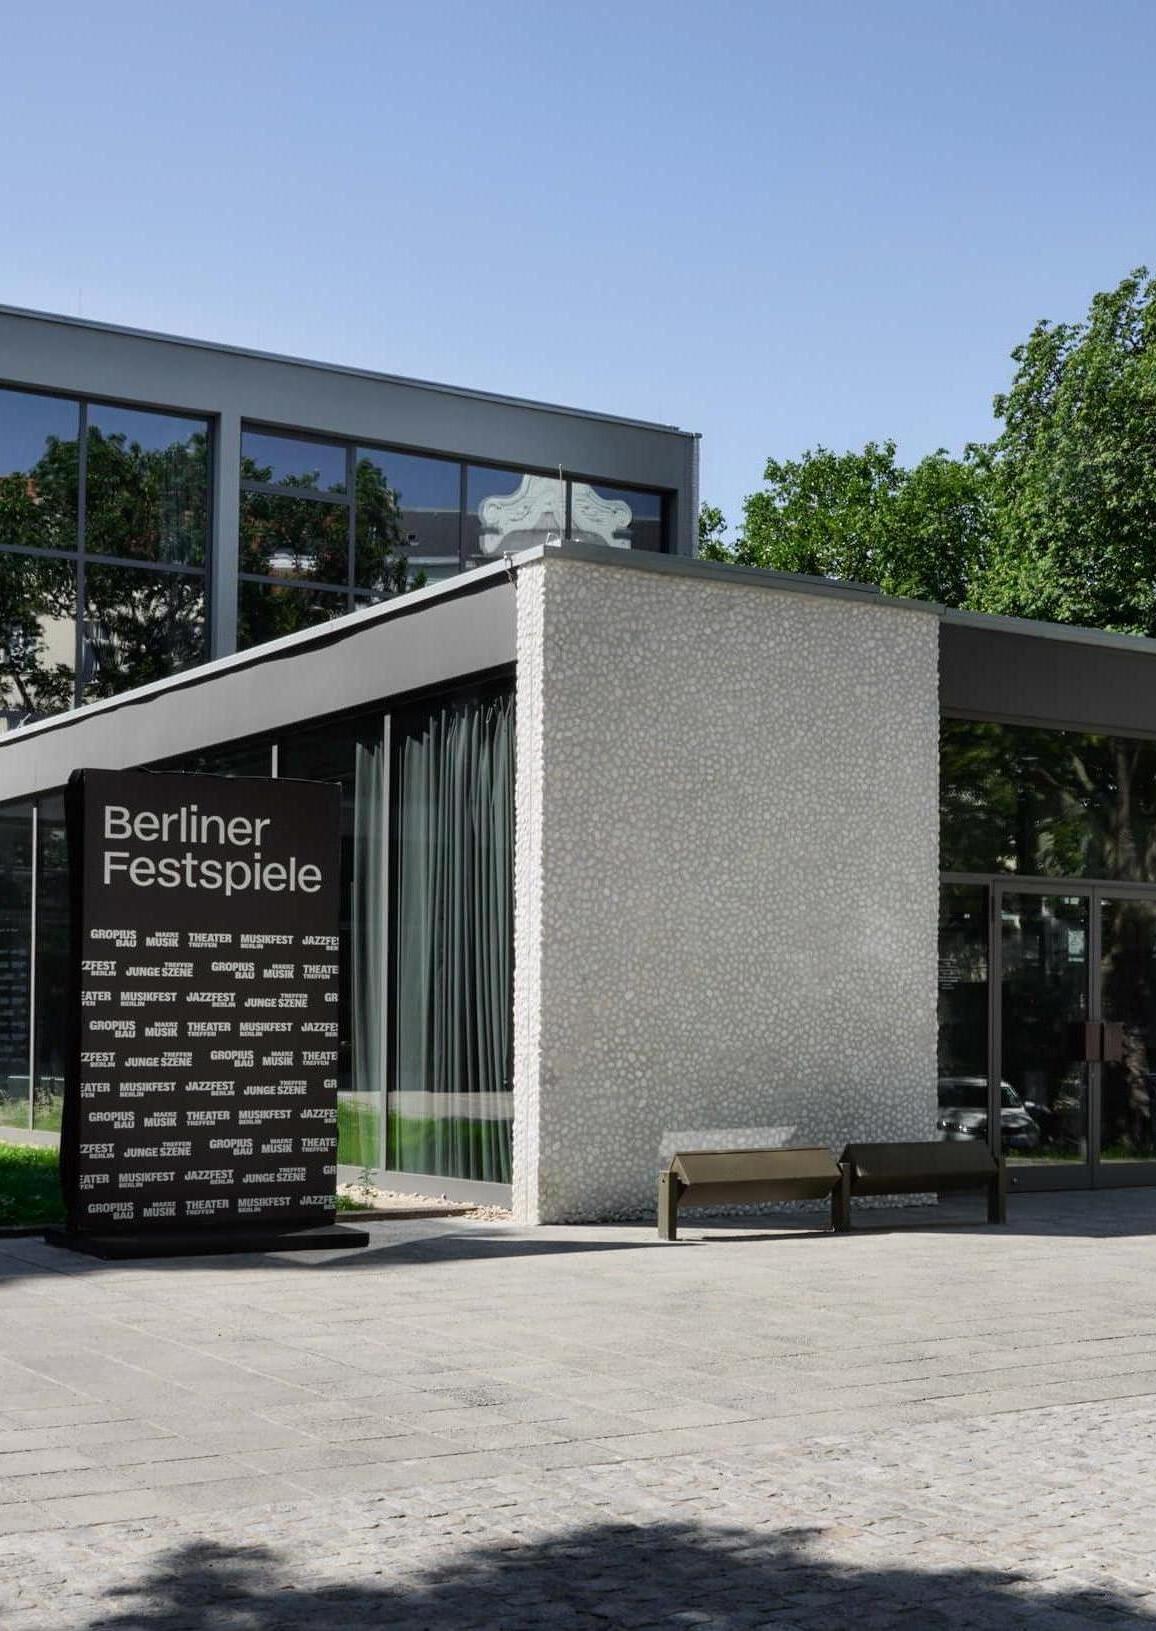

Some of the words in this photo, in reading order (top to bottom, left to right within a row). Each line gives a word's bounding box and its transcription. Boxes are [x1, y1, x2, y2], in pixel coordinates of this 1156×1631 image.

[104, 804, 271, 846] Berliner
[103, 851, 322, 896] Festspiele
[91, 929, 136, 940] GROPIUS
[188, 933, 232, 943] THEATER
[240, 934, 294, 944] MUSIKFEST
[116, 939, 136, 947] BAU
[146, 937, 178, 947] MUSIK
[126, 967, 160, 976] JUNGE
[162, 967, 193, 977] SZENE
[211, 962, 254, 972] GROPIUS
[263, 969, 294, 978] MUSIK
[121, 992, 177, 1002] MUSIKFEST
[186, 992, 236, 1002] JAZZFEST
[244, 998, 277, 1008] JUNGE
[278, 998, 308, 1008] SZENE
[89, 1020, 136, 1030] GROPIUS
[187, 1022, 231, 1031] THEATER
[240, 1022, 293, 1032] MUSIKFEST
[115, 1030, 136, 1038] BAU
[145, 1027, 178, 1037] MUSIK
[210, 1050, 254, 1060] GROPIUS
[125, 1057, 159, 1067] JUNGE
[161, 1057, 192, 1067] SZENE
[262, 1056, 293, 1066] MUSIK
[120, 1082, 176, 1092] MUSIKFEST
[185, 1081, 235, 1091] JAZZFEST
[244, 1086, 276, 1095] JUNGE
[277, 1085, 307, 1095] SZENE
[89, 1112, 135, 1121] GROPIUS
[187, 1111, 230, 1120] THEATER
[239, 1110, 292, 1119] MUSIKFEST
[144, 1117, 176, 1127] MUSIK
[210, 1138, 253, 1148] GROPIUS
[124, 1148, 158, 1157] JUNGE
[160, 1146, 191, 1156] SZENE
[233, 1147, 253, 1155] BAU
[261, 1144, 292, 1153] MUSIK
[119, 1172, 176, 1183] MUSIKFEST
[185, 1169, 234, 1180] JAZZFEST
[243, 1173, 275, 1183] JUNGE
[276, 1172, 306, 1182] SZENE
[88, 1202, 134, 1213] GROPIUS
[186, 1199, 229, 1210] THEATER
[238, 1197, 291, 1208] MUSIKFEST
[143, 1207, 176, 1217] MUSIK
